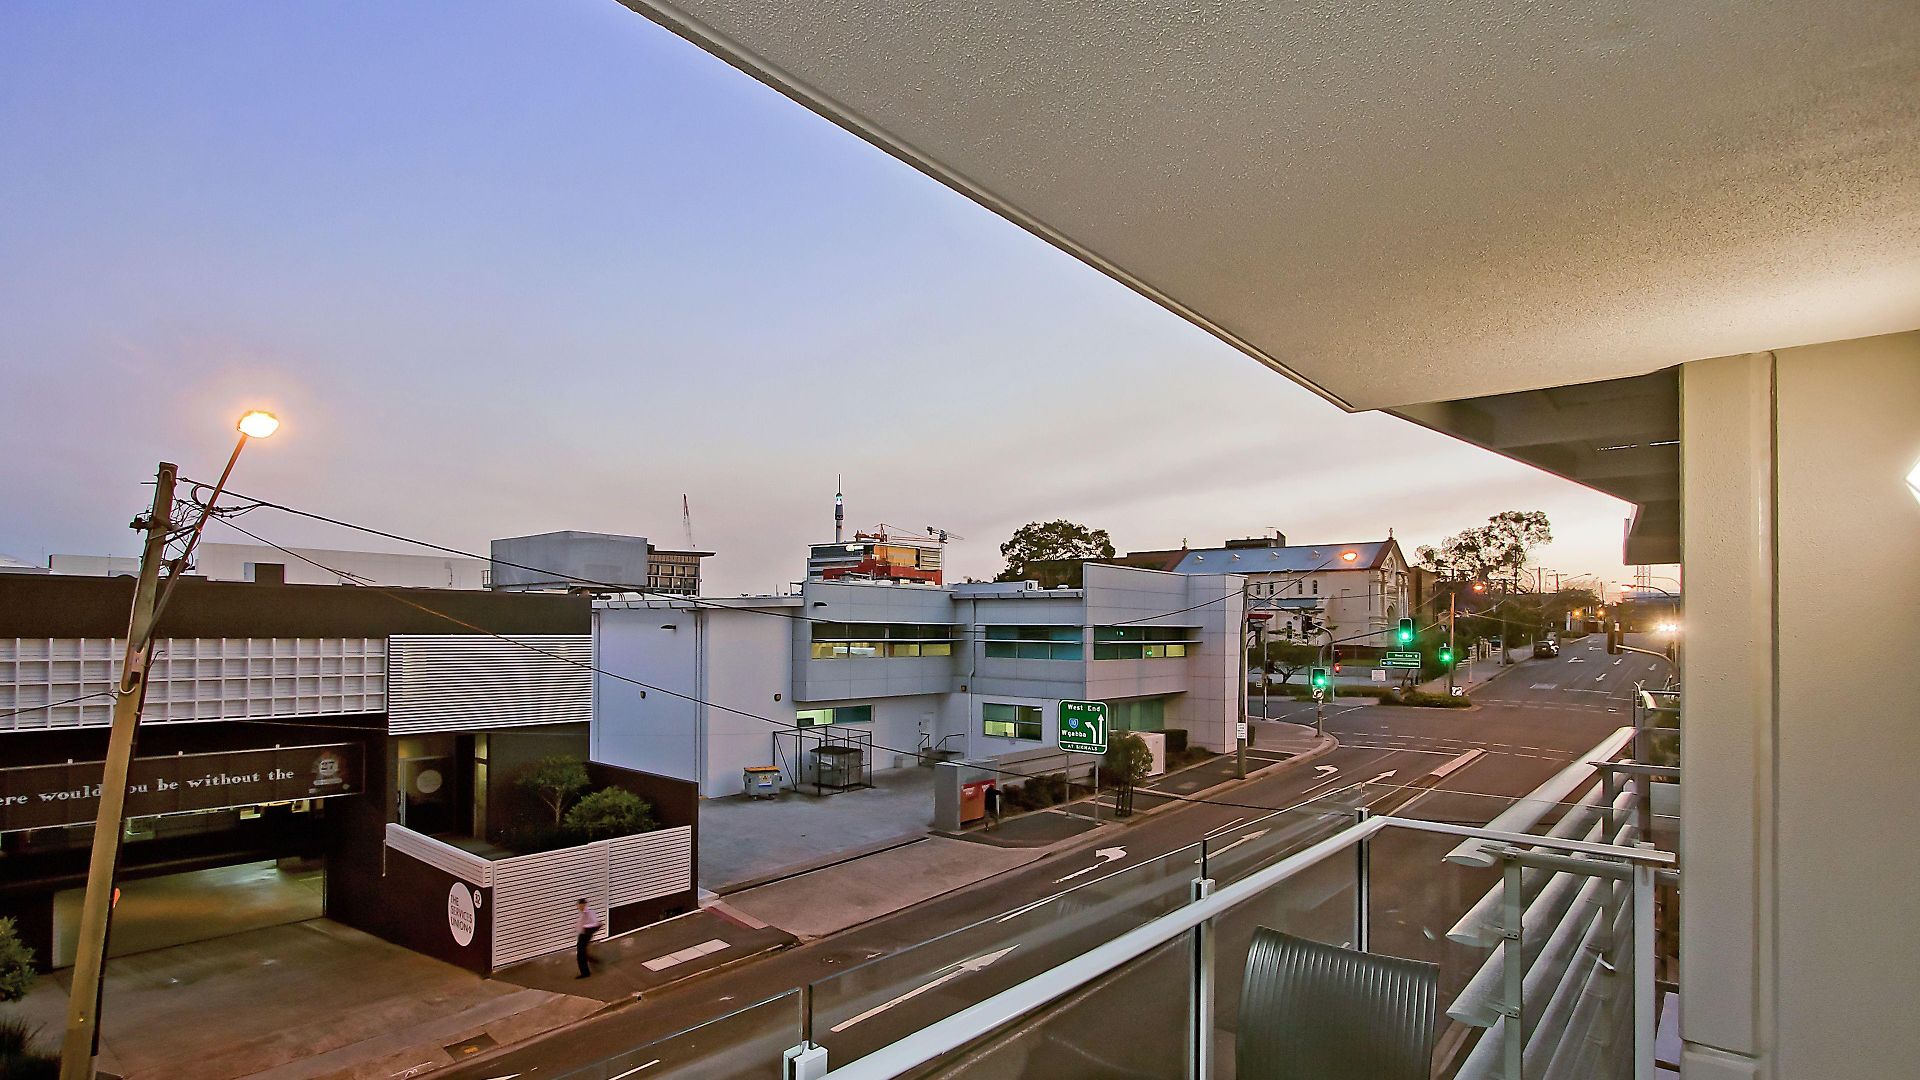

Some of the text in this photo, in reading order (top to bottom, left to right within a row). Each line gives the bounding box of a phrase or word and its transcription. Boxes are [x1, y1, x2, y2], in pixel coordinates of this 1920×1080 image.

[1067, 703, 1083, 711] West
[38, 783, 104, 801] would
[157, 778, 179, 791] be
[186, 772, 260, 788] without
[268, 768, 294, 781] the
[450, 894, 459, 906] THE
[450, 905, 473, 923] SERVICES
